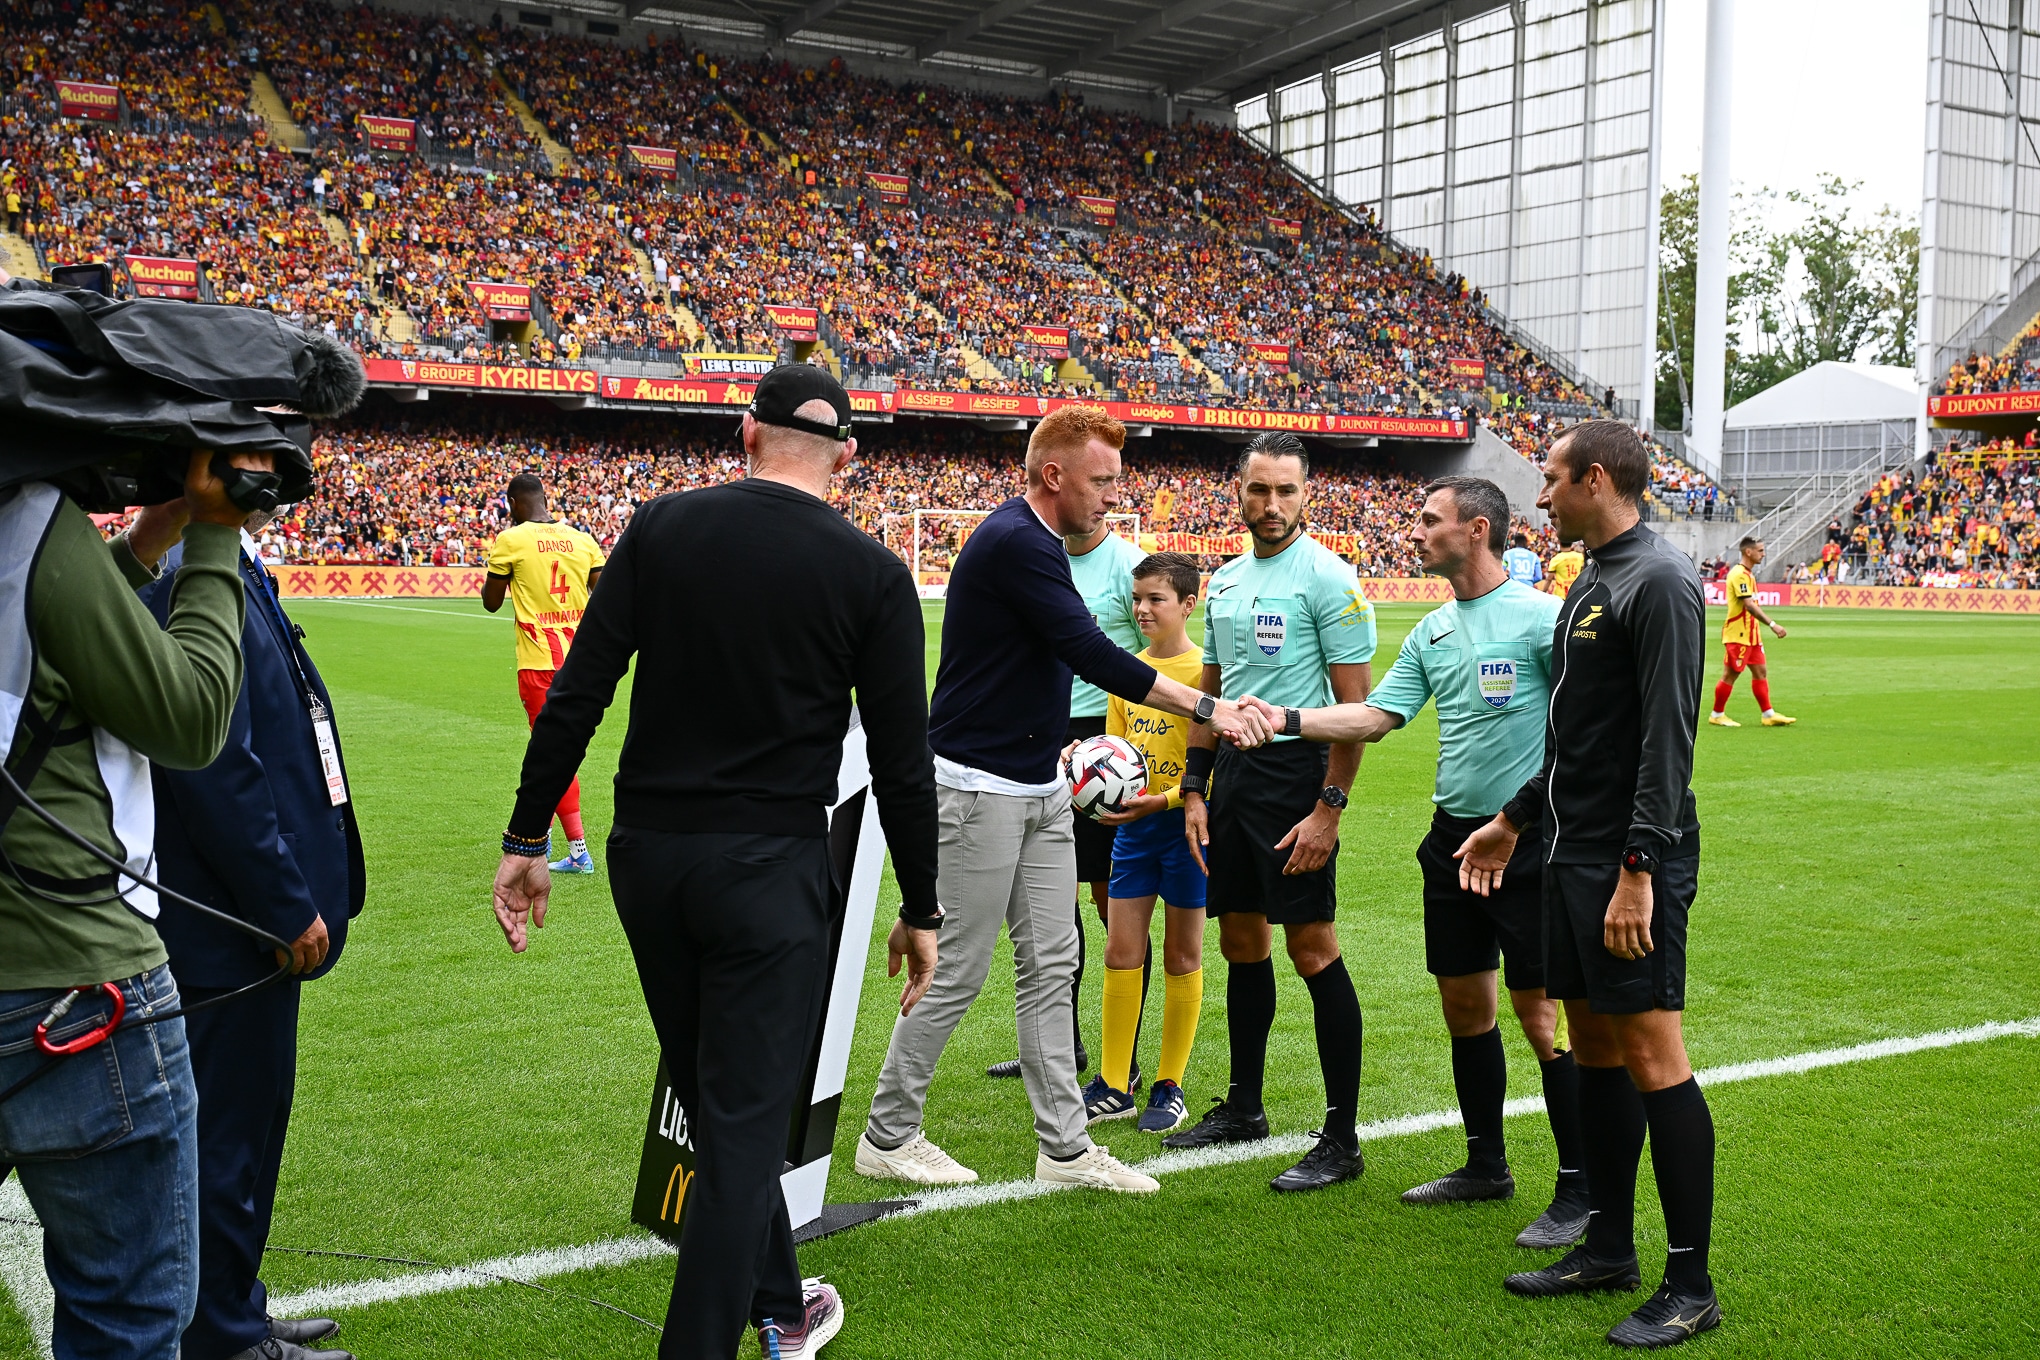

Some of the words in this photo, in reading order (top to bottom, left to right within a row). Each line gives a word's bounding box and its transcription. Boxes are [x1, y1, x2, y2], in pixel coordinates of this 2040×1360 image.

[59, 86, 117, 106] Auchan
[362, 119, 410, 137] Auchan
[632, 149, 675, 166] Auchan
[129, 260, 195, 282] Auchan
[768, 309, 815, 327] Auchan
[1024, 329, 1067, 346] Auchan
[701, 359, 730, 373] LENS
[732, 360, 774, 375] CENTRE
[420, 367, 475, 382] GROUPE
[481, 366, 595, 391] KYRIELYS
[634, 379, 708, 403] Auchan
[1131, 406, 1174, 420] waigéo
[1947, 396, 2007, 414] DUPONT
[1204, 409, 1262, 427] BRICO
[1265, 412, 1321, 430] DEPOT
[1340, 419, 1379, 430] DUPONT
[1381, 421, 1439, 432] RESTAURATION
[537, 540, 573, 553] DANSO
[1156, 533, 1244, 552] SANCTIONS
[1514, 559, 1530, 574] 30
[1565, 562, 1578, 577] 14
[550, 560, 571, 604] 4
[536, 609, 584, 625] WINAMAX
[1257, 615, 1283, 626] FIFA
[1579, 631, 1597, 640] POSTE
[1738, 646, 1746, 659] 2
[1481, 663, 1513, 675] FIFA
